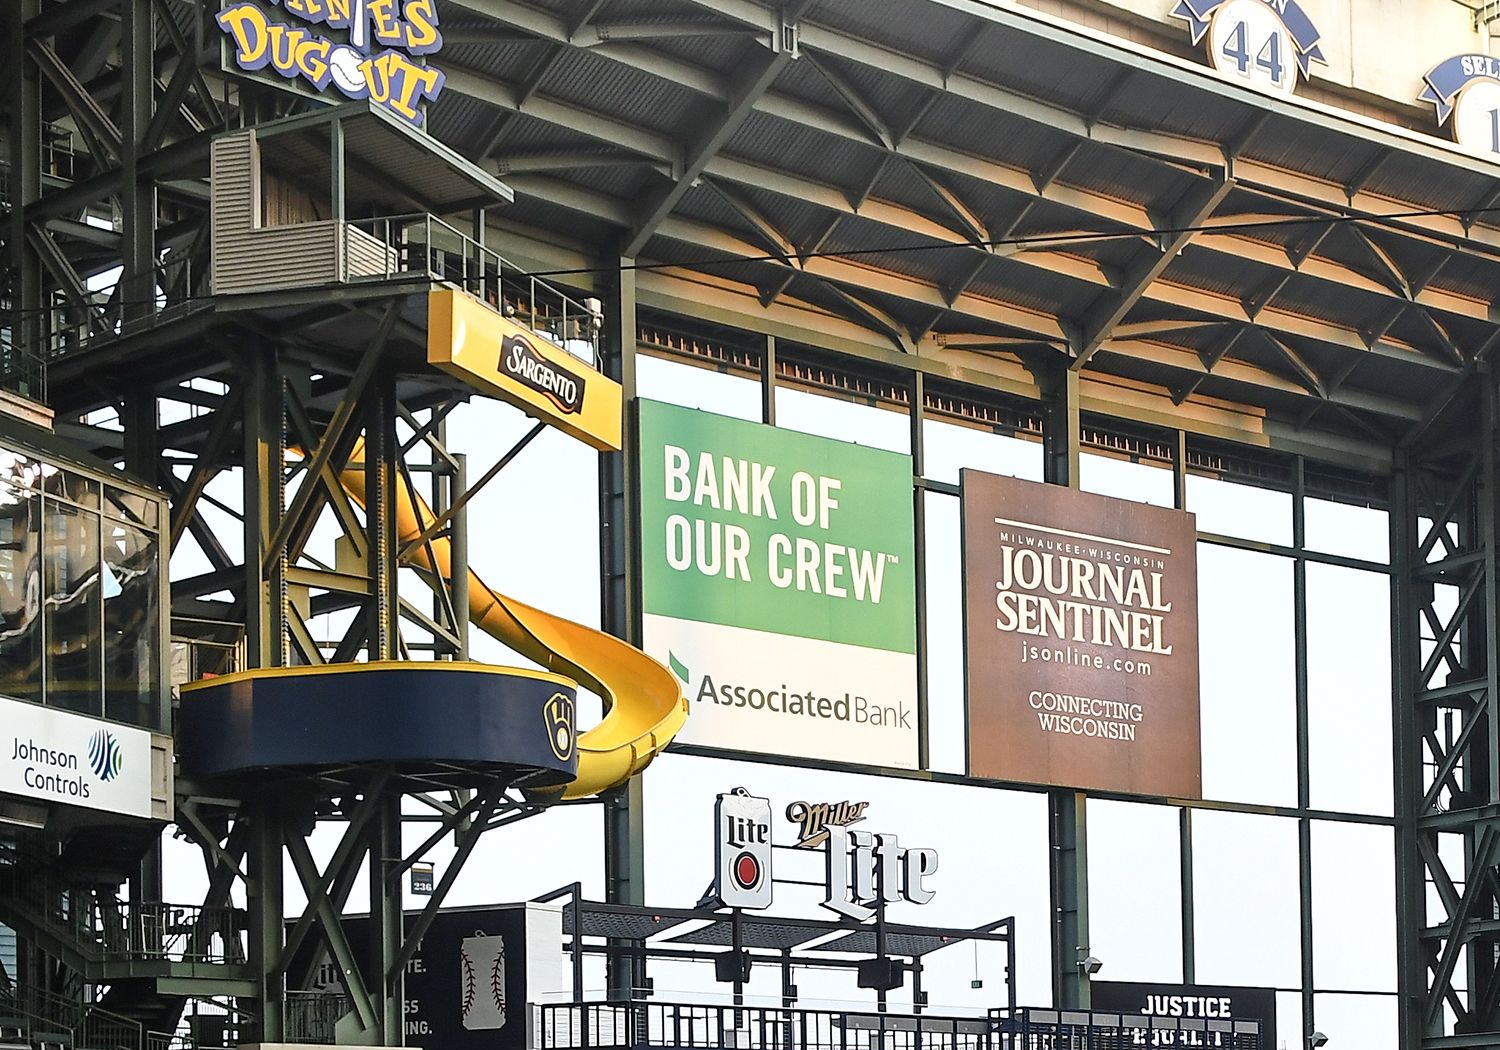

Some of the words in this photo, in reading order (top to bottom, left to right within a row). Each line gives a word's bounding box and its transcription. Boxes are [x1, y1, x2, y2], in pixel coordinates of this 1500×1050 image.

[220, 5, 439, 120] DUGOUT
[1222, 20, 1284, 84] 44
[1485, 107, 1500, 154] 1
[506, 345, 577, 404] SARGENTO
[662, 443, 779, 522] BANK
[789, 470, 843, 530] OF
[664, 513, 751, 584] OUR
[995, 544, 1172, 613] JOURNAL
[995, 590, 1173, 656] SENTINEL
[1021, 640, 1152, 676] jsonline.com
[1028, 690, 1144, 723] CONNECTING
[1037, 712, 1136, 742] WISCONSIN
[11, 737, 78, 770] Johnson
[24, 766, 90, 799] Controls
[725, 814, 769, 850] Lite
[785, 799, 870, 841] Miller
[413, 882, 433, 892] 236
[818, 823, 939, 922] Lite
[1140, 994, 1232, 1018] JUSTICE
